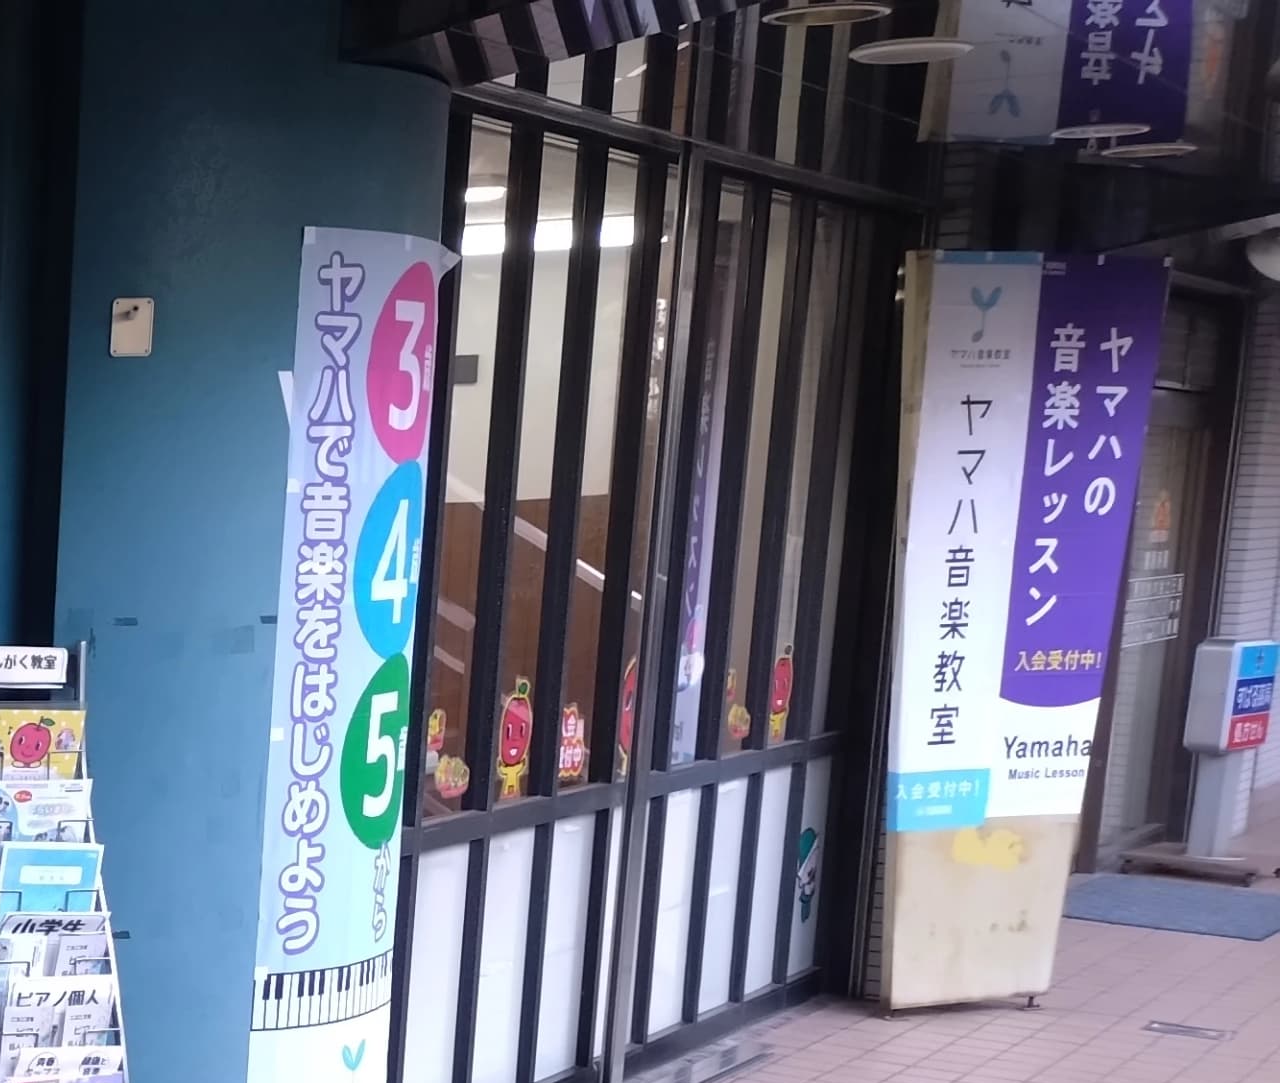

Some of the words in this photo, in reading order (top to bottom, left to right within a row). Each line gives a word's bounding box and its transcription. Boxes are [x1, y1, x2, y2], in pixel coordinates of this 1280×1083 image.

[1084, 326, 1134, 517] ヤマハの
[1026, 322, 1087, 627] 音楽レッスン
[926, 394, 993, 746] ヤマハ音楽教室
[276, 250, 366, 954] ヤマハで音楽をはじめよう
[1013, 650, 1102, 673] 入会受付中!
[1003, 735, 1095, 761] Yamaha
[1008, 767, 1041, 780] Music
[1044, 766, 1086, 779] Lesson
[12, 918, 86, 936] 小学生
[16, 988, 100, 1008] ピアノ個人
